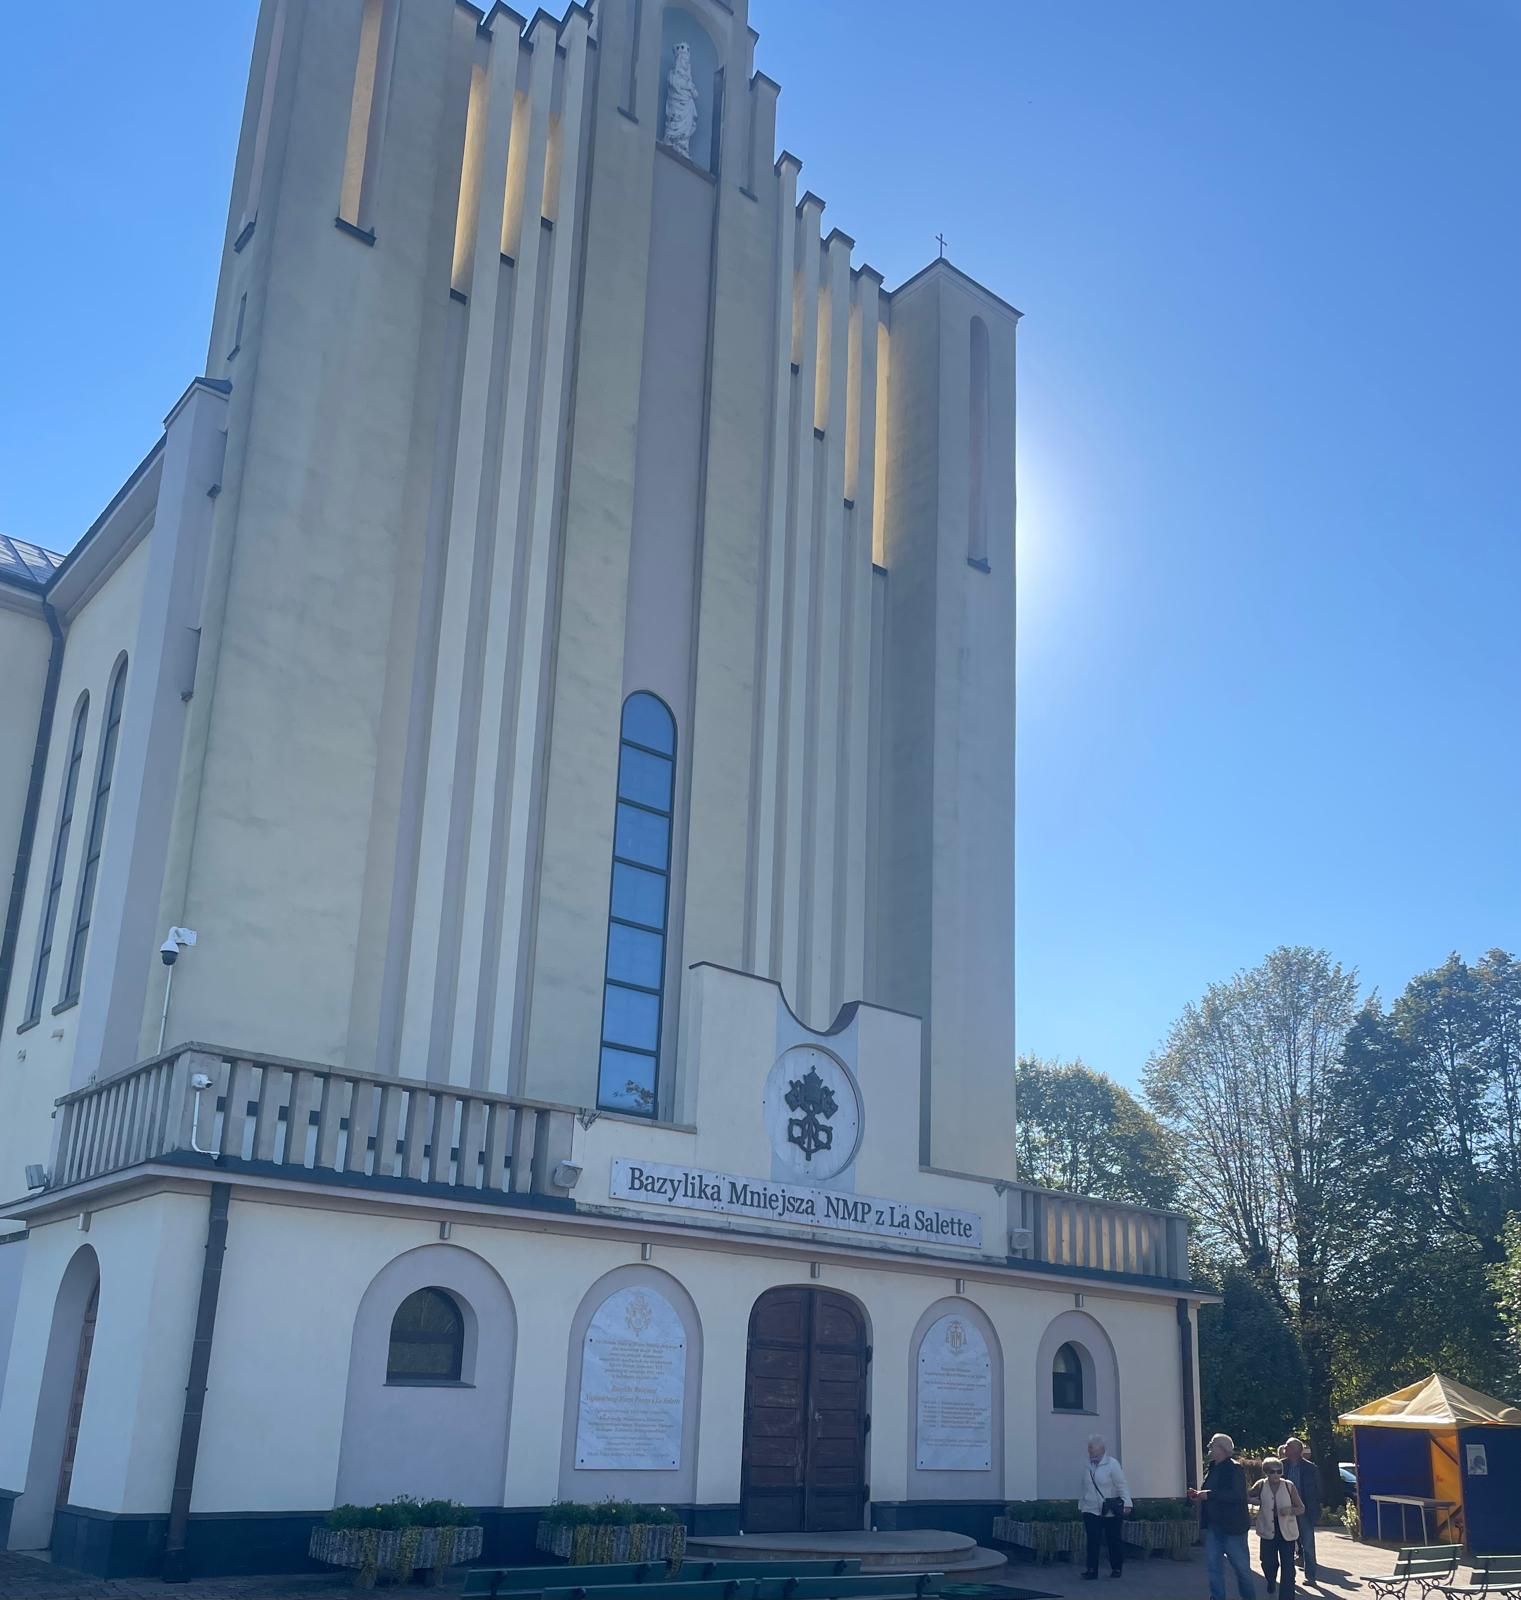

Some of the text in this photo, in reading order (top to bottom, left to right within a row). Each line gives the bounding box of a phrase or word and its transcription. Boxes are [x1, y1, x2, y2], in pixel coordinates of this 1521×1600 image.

[628, 1167, 972, 1239] Bazylika Mniejsza NMP z La Salette
